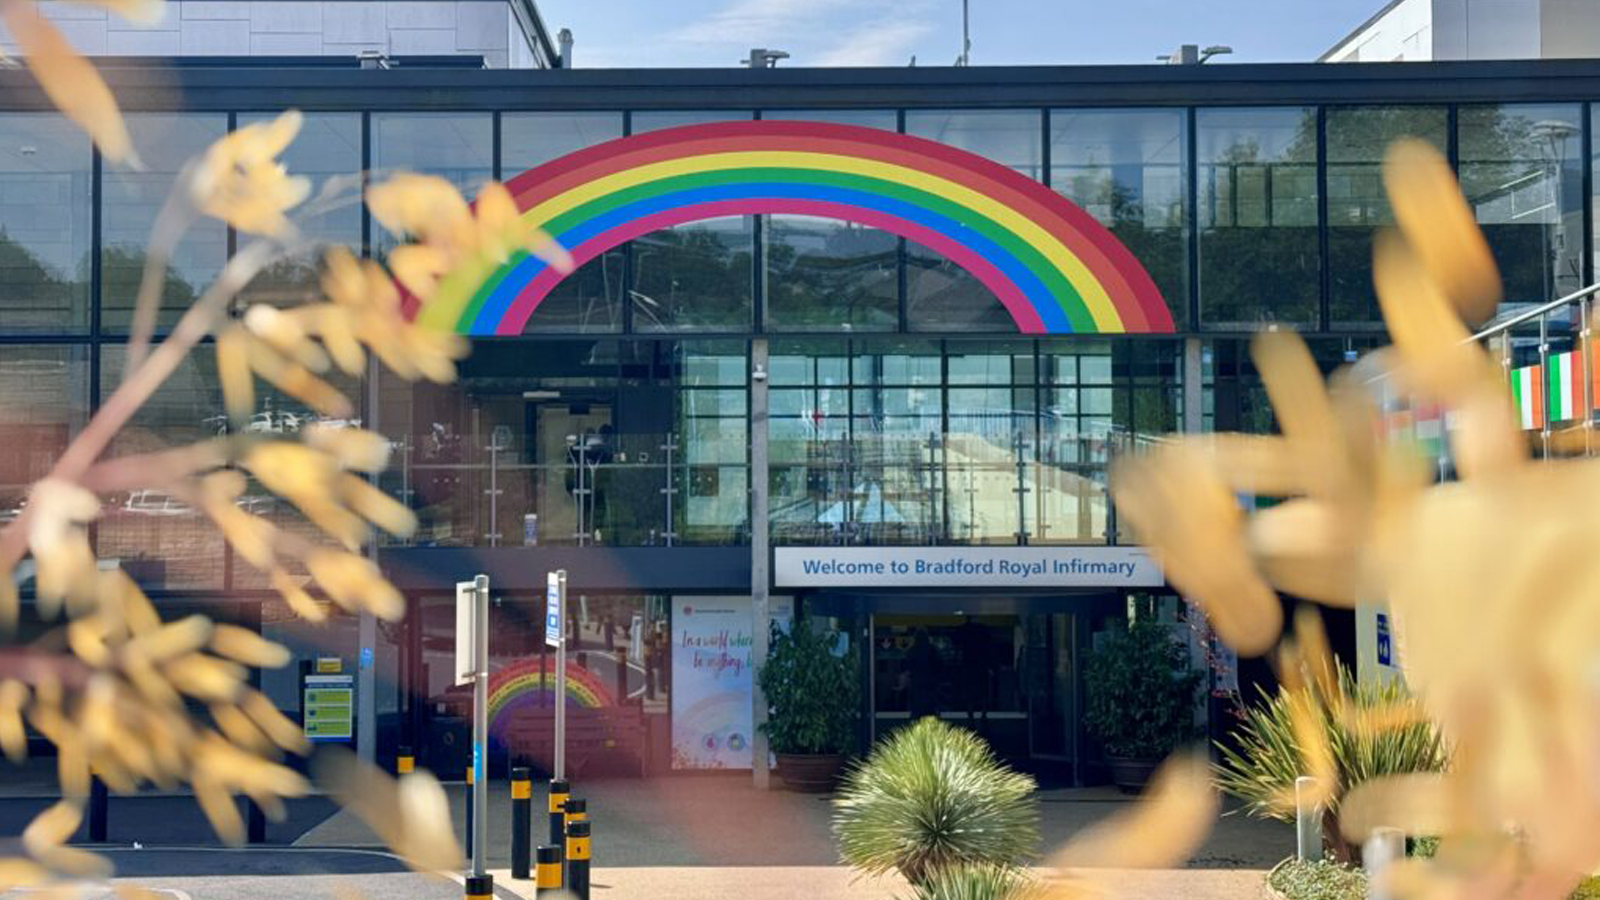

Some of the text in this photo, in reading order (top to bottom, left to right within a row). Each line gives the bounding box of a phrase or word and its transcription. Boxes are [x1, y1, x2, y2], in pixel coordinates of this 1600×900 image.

[803, 558, 1136, 578] Welcome to Bradford Royal Infirmary
